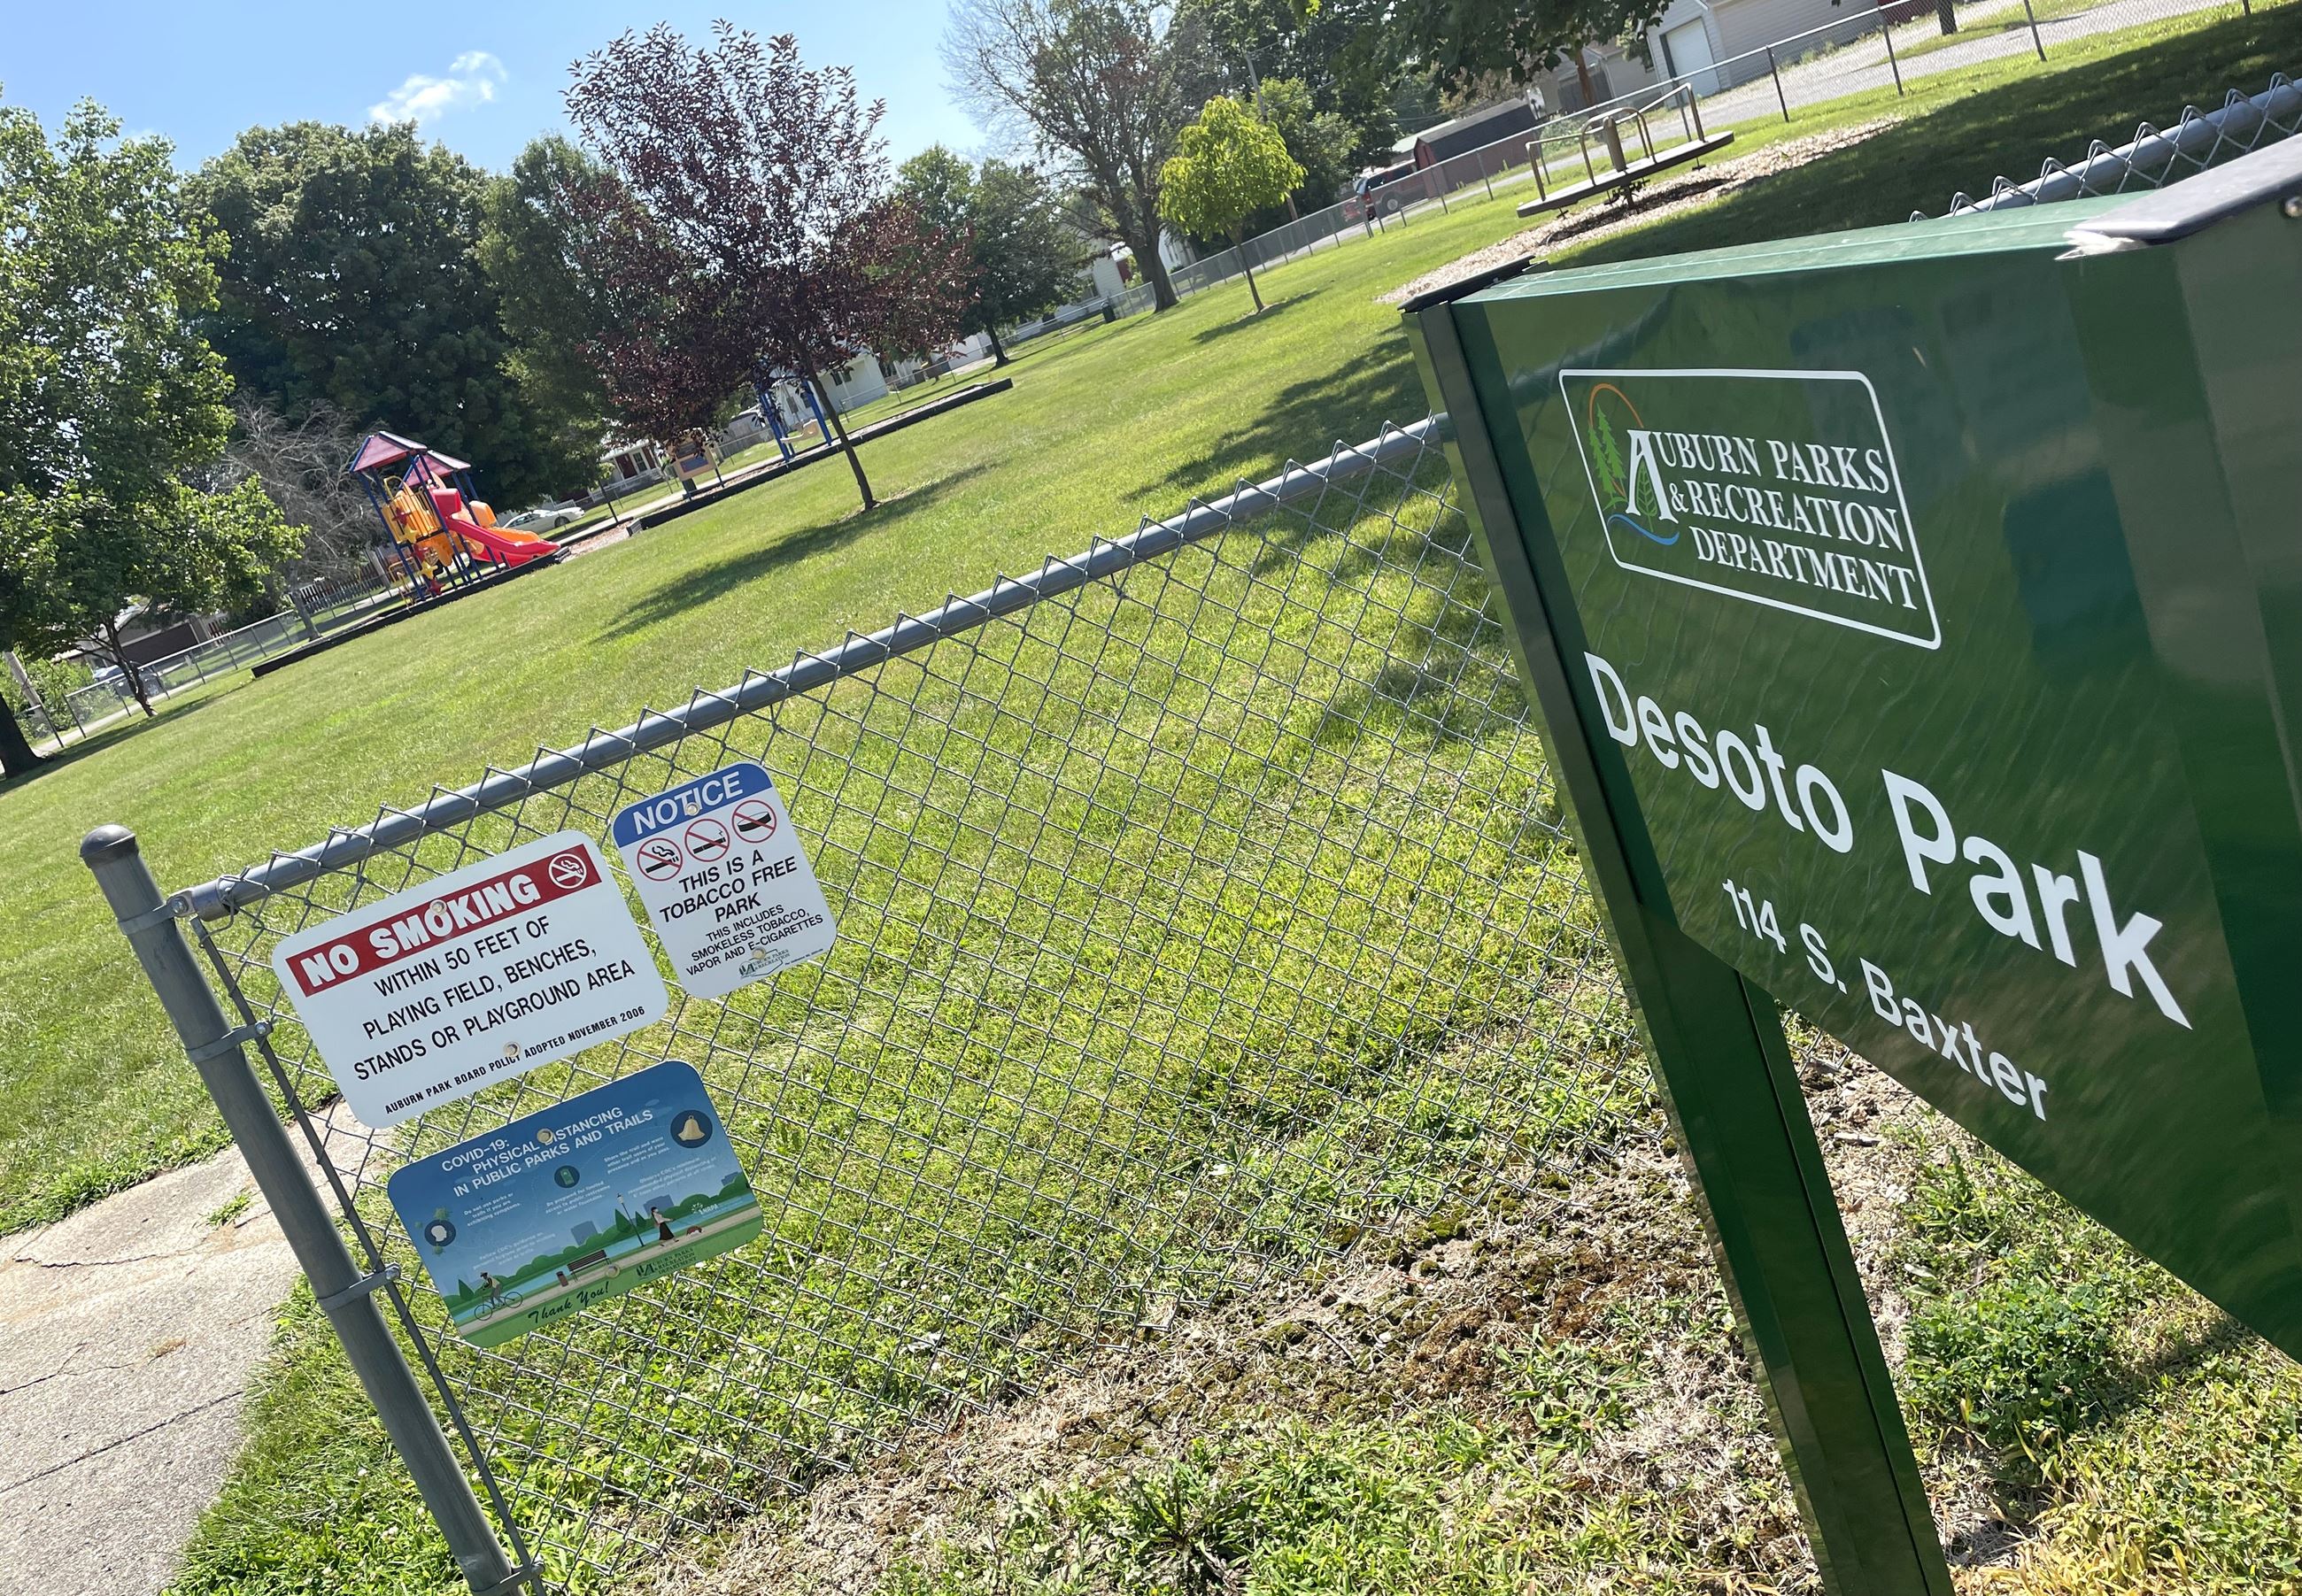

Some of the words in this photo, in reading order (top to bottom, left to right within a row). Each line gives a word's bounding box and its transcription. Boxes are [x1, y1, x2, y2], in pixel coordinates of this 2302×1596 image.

[1626, 429, 1761, 524] AUBURN
[1766, 440, 1889, 494] PARKS
[1689, 526, 1918, 610] DEPARTMENT
[632, 771, 744, 835] NOTICE
[679, 867, 720, 893] THIS
[726, 857, 744, 875] IS
[752, 849, 763, 865] A
[1584, 652, 1854, 853] Desoto
[1881, 767, 2193, 1029] Park
[660, 878, 745, 923] TOBACCO
[752, 856, 797, 886] FREE
[706, 927, 730, 942] THIS
[732, 905, 784, 929] INCLUDES
[715, 893, 761, 922] PARK
[300, 944, 359, 988] NO
[369, 874, 541, 959] SMOKING
[375, 960, 441, 997] WITHIN
[444, 947, 467, 970] 50
[474, 927, 521, 956] FEET
[527, 916, 551, 939] OF
[686, 958, 721, 975] VAPOR
[725, 947, 745, 961] AND
[749, 914, 823, 951] E-CIGARETTES
[691, 929, 755, 961] SMOKELESS
[757, 908, 809, 933] TOBACCO,
[353, 1038, 427, 1081] STANDS
[431, 1025, 460, 1048] OR
[463, 979, 580, 1036] PLAYGROUND
[588, 960, 635, 986] AREA
[362, 996, 441, 1040] PLAYING
[444, 976, 504, 1008] FIELD,
[503, 938, 598, 984] BENCHES,
[1722, 878, 1786, 954] 114
[1800, 923, 1847, 994] S.
[1859, 958, 2047, 1122] Baxter
[385, 1091, 423, 1114] AUBURN
[426, 1080, 452, 1098] PARK
[454, 1066, 487, 1085] BOARD
[524, 1033, 565, 1058] ADOPTED
[568, 1016, 619, 1041] NOVEMBER
[619, 1006, 645, 1023] 2006
[442, 1138, 509, 1172] COVID-19:
[452, 1183, 469, 1197] IN
[472, 1163, 521, 1189] PUBLIC
[524, 1143, 570, 1168] PARKS
[575, 1130, 603, 1148] AND
[606, 1109, 653, 1136] TRAILS
[472, 1142, 539, 1174] PHYSICAL
[544, 1107, 623, 1145] ISTANCING
[528, 1299, 573, 1324] Thank
[576, 1282, 609, 1307] You!
